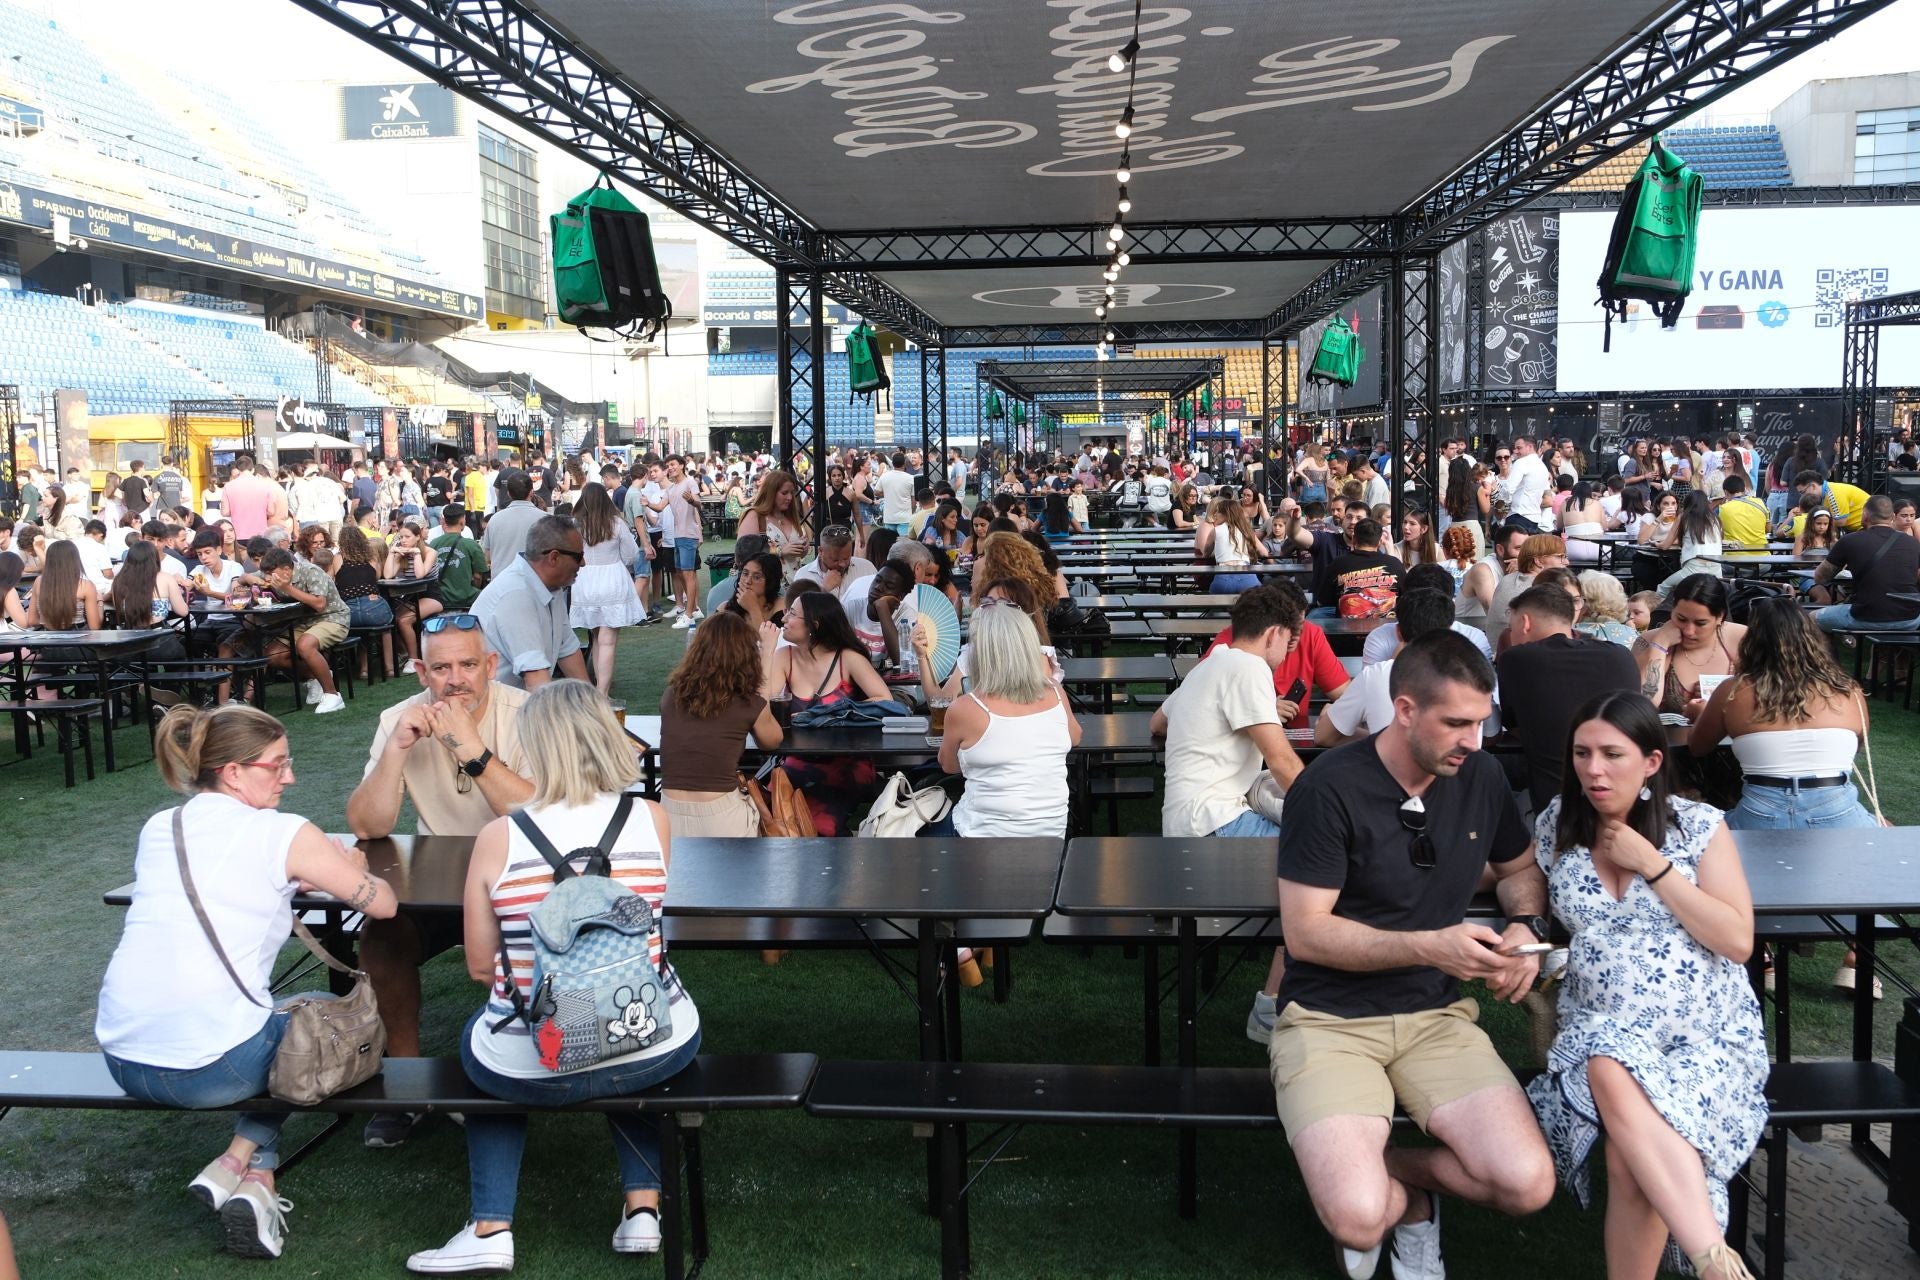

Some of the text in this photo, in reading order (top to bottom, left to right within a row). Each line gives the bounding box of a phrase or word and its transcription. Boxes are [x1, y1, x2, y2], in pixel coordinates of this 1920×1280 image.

[371, 124, 430, 138] CaixaBank
[87, 205, 130, 226] Occidental
[1652, 207, 1674, 225] Eats
[89, 221, 110, 238] Cádiz
[1489, 262, 1515, 293] Custom
[1699, 270, 1714, 291] Y
[1719, 269, 1784, 291] GANA
[441, 291, 460, 306] RESET
[713, 310, 750, 321] coanda
[1621, 413, 1653, 436] The
[1763, 412, 1794, 434] The
